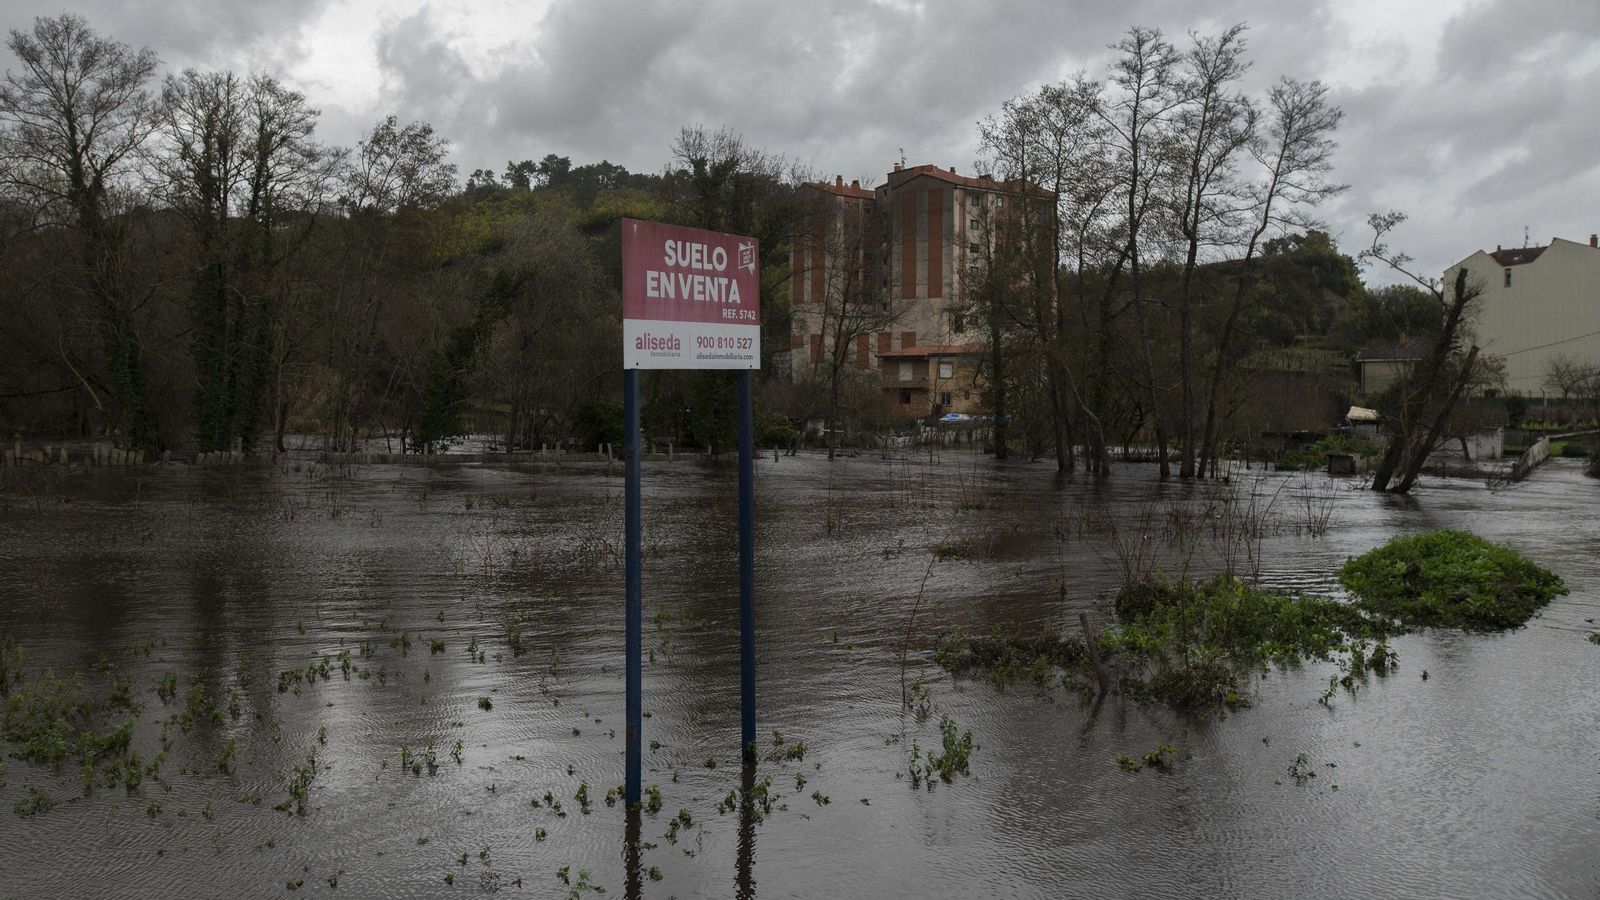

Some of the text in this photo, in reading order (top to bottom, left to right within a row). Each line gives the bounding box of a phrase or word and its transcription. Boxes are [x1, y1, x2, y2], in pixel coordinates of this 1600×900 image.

[664, 239, 728, 271] SUELO
[646, 270, 741, 304] EN VENTA
[722, 308, 756, 320] REF. 5742
[635, 332, 681, 350] aliseda
[696, 336, 753, 350] 900 810 527
